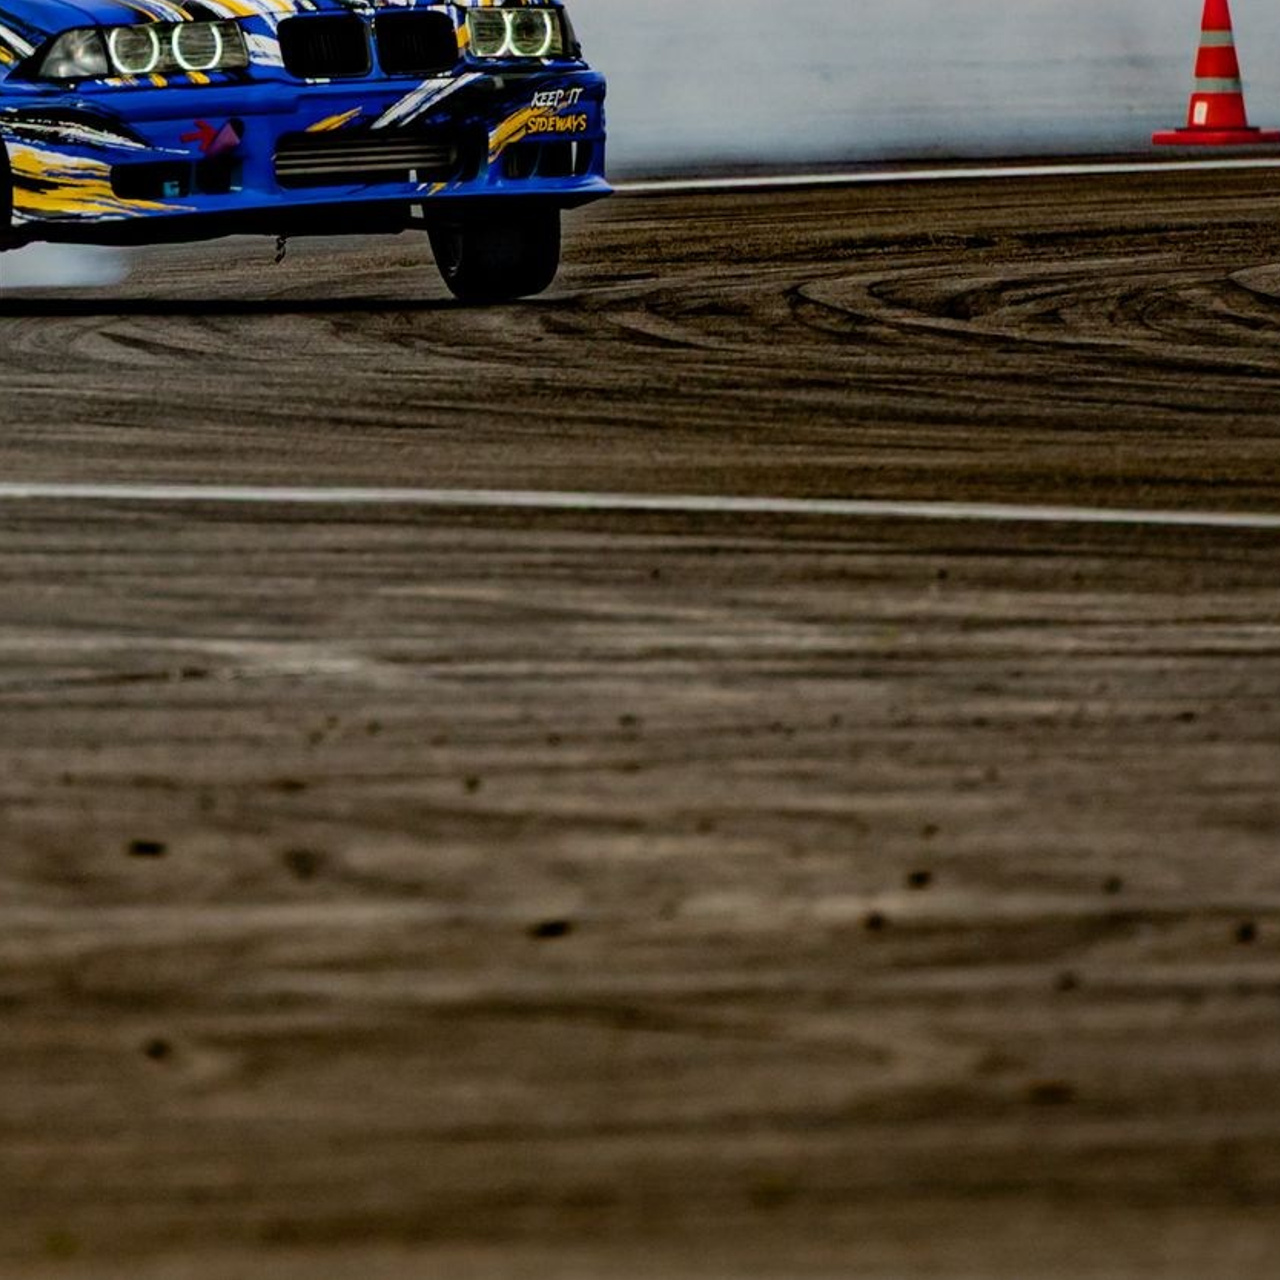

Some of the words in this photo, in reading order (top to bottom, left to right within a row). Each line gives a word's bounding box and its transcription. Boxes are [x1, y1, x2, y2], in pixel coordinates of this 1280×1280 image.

[531, 89, 565, 107] KEEP
[567, 88, 584, 104] IT
[527, 114, 588, 134] SIDEWAYS
